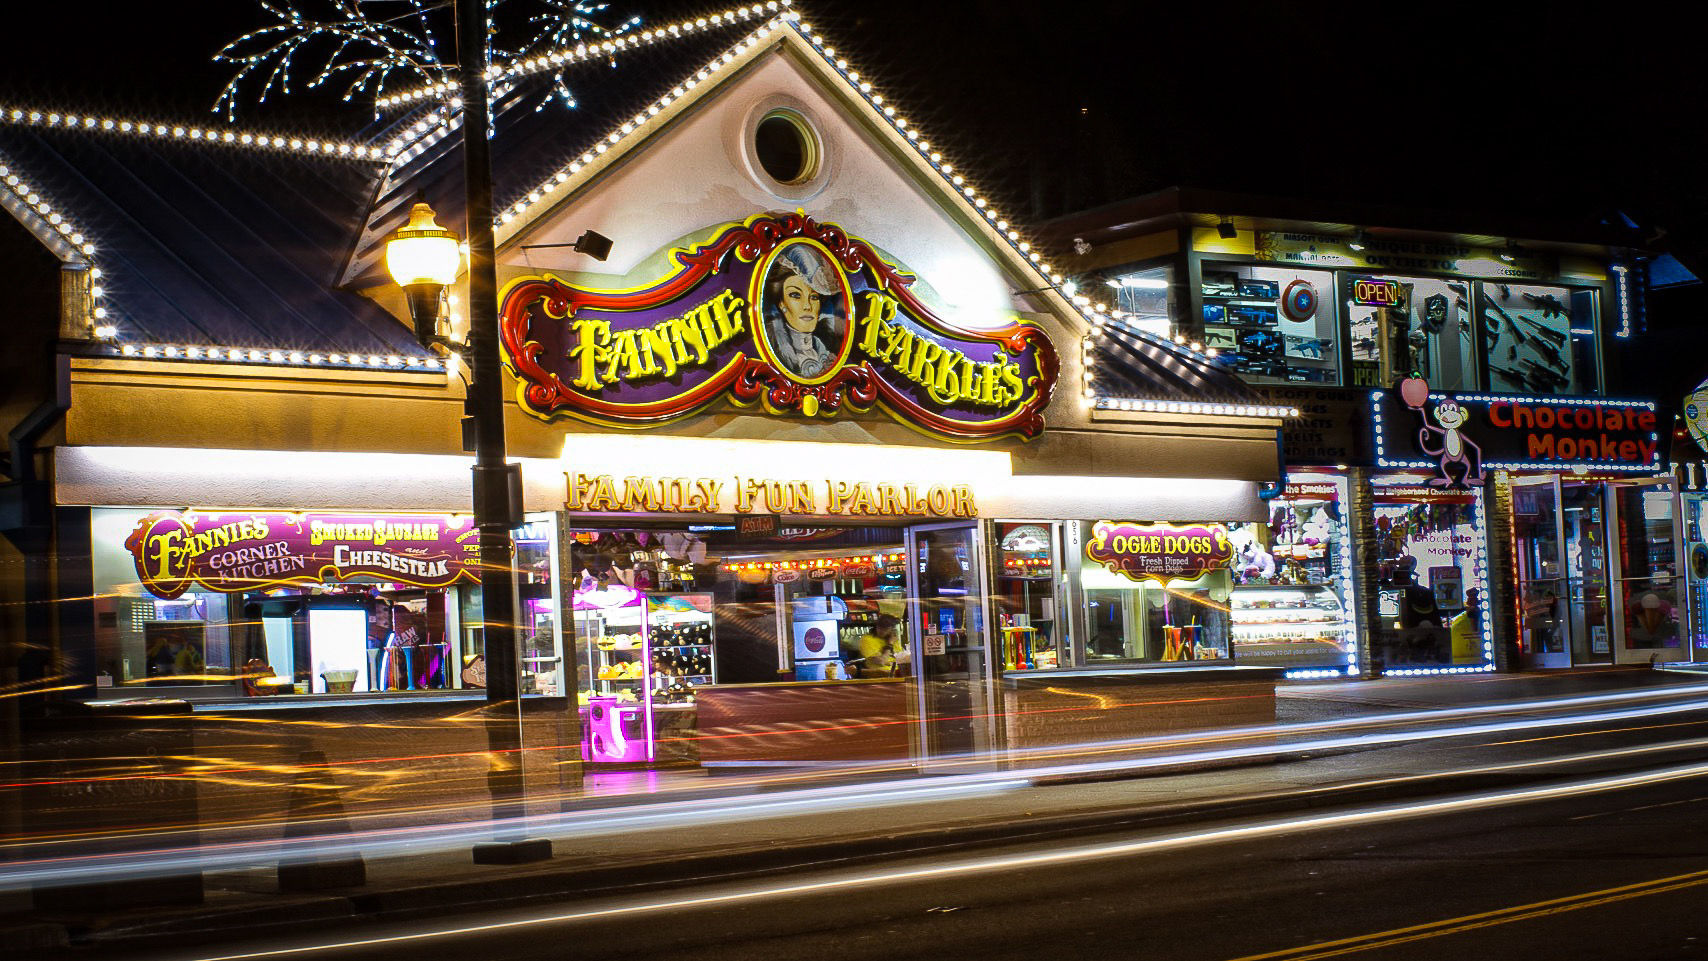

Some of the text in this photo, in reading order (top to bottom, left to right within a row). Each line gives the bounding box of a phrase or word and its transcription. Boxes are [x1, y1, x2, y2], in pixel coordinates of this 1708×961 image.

[1424, 243, 1470, 258] SHOP
[1366, 255, 1391, 266] ON
[1394, 256, 1428, 268] THE
[1358, 283, 1395, 302] OPEN
[569, 289, 1024, 408] FANNIE FARKLE'S
[1489, 401, 1656, 431] Chocolate
[1527, 433, 1657, 465] Monkey
[563, 471, 978, 518] FAMILY FUN PARLOR
[1285, 483, 1336, 494] the Smokies
[1386, 487, 1429, 497] Neighborhood
[310, 519, 373, 546] SMOKED
[373, 519, 440, 546] SAUSAGE
[741, 516, 774, 533] ATM
[1112, 535, 1212, 554] OGLE DOGS
[1415, 533, 1472, 543] Chocolate
[209, 540, 291, 569] CORNER
[404, 546, 429, 555] and
[1427, 548, 1472, 558] Monkey
[218, 554, 305, 584] KITCHEN
[333, 545, 450, 578] CHEESESTEAK
[886, 565, 899, 573] ICE
[1140, 555, 1189, 567] Fresh Dipped
[811, 569, 835, 578] Pepper
[1145, 565, 1184, 575] Corn Dogs
[391, 626, 417, 646] RAW
